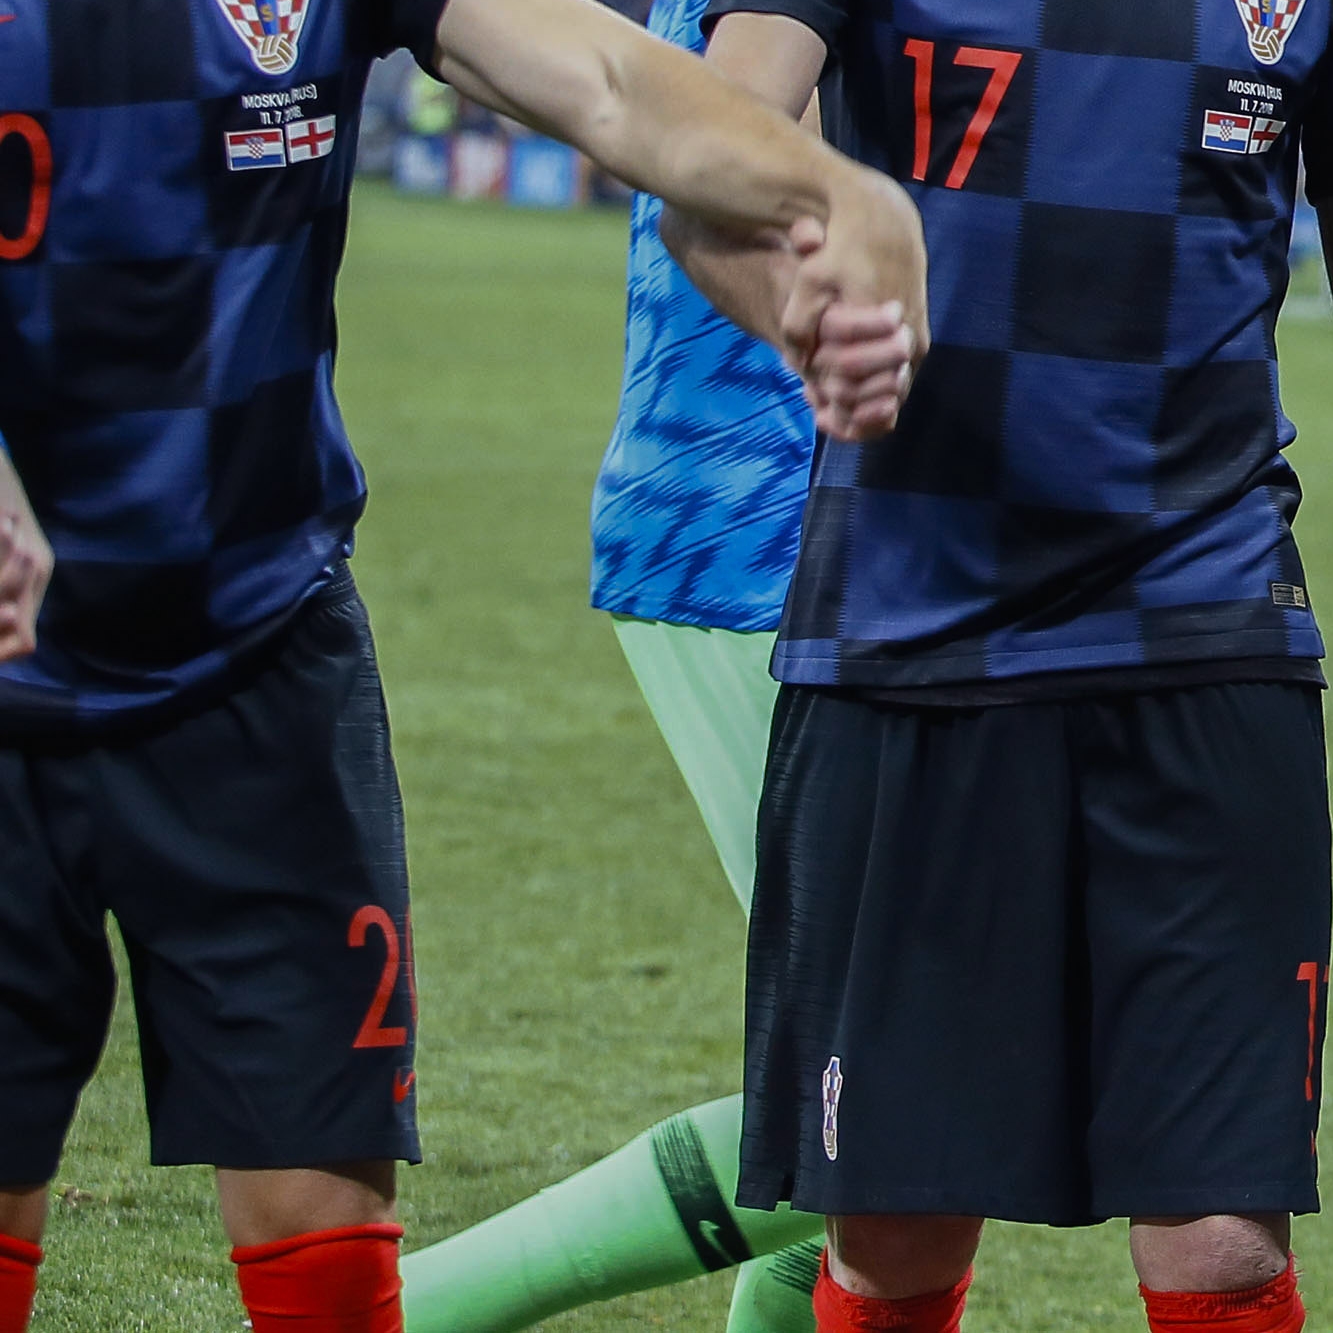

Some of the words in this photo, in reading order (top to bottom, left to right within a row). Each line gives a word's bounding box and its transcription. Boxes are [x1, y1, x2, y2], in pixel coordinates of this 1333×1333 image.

[241, 91, 291, 110] MOSKVA
[904, 38, 1022, 189] 17
[1227, 79, 1266, 98] MOSKVA
[347, 904, 418, 1048] 2
